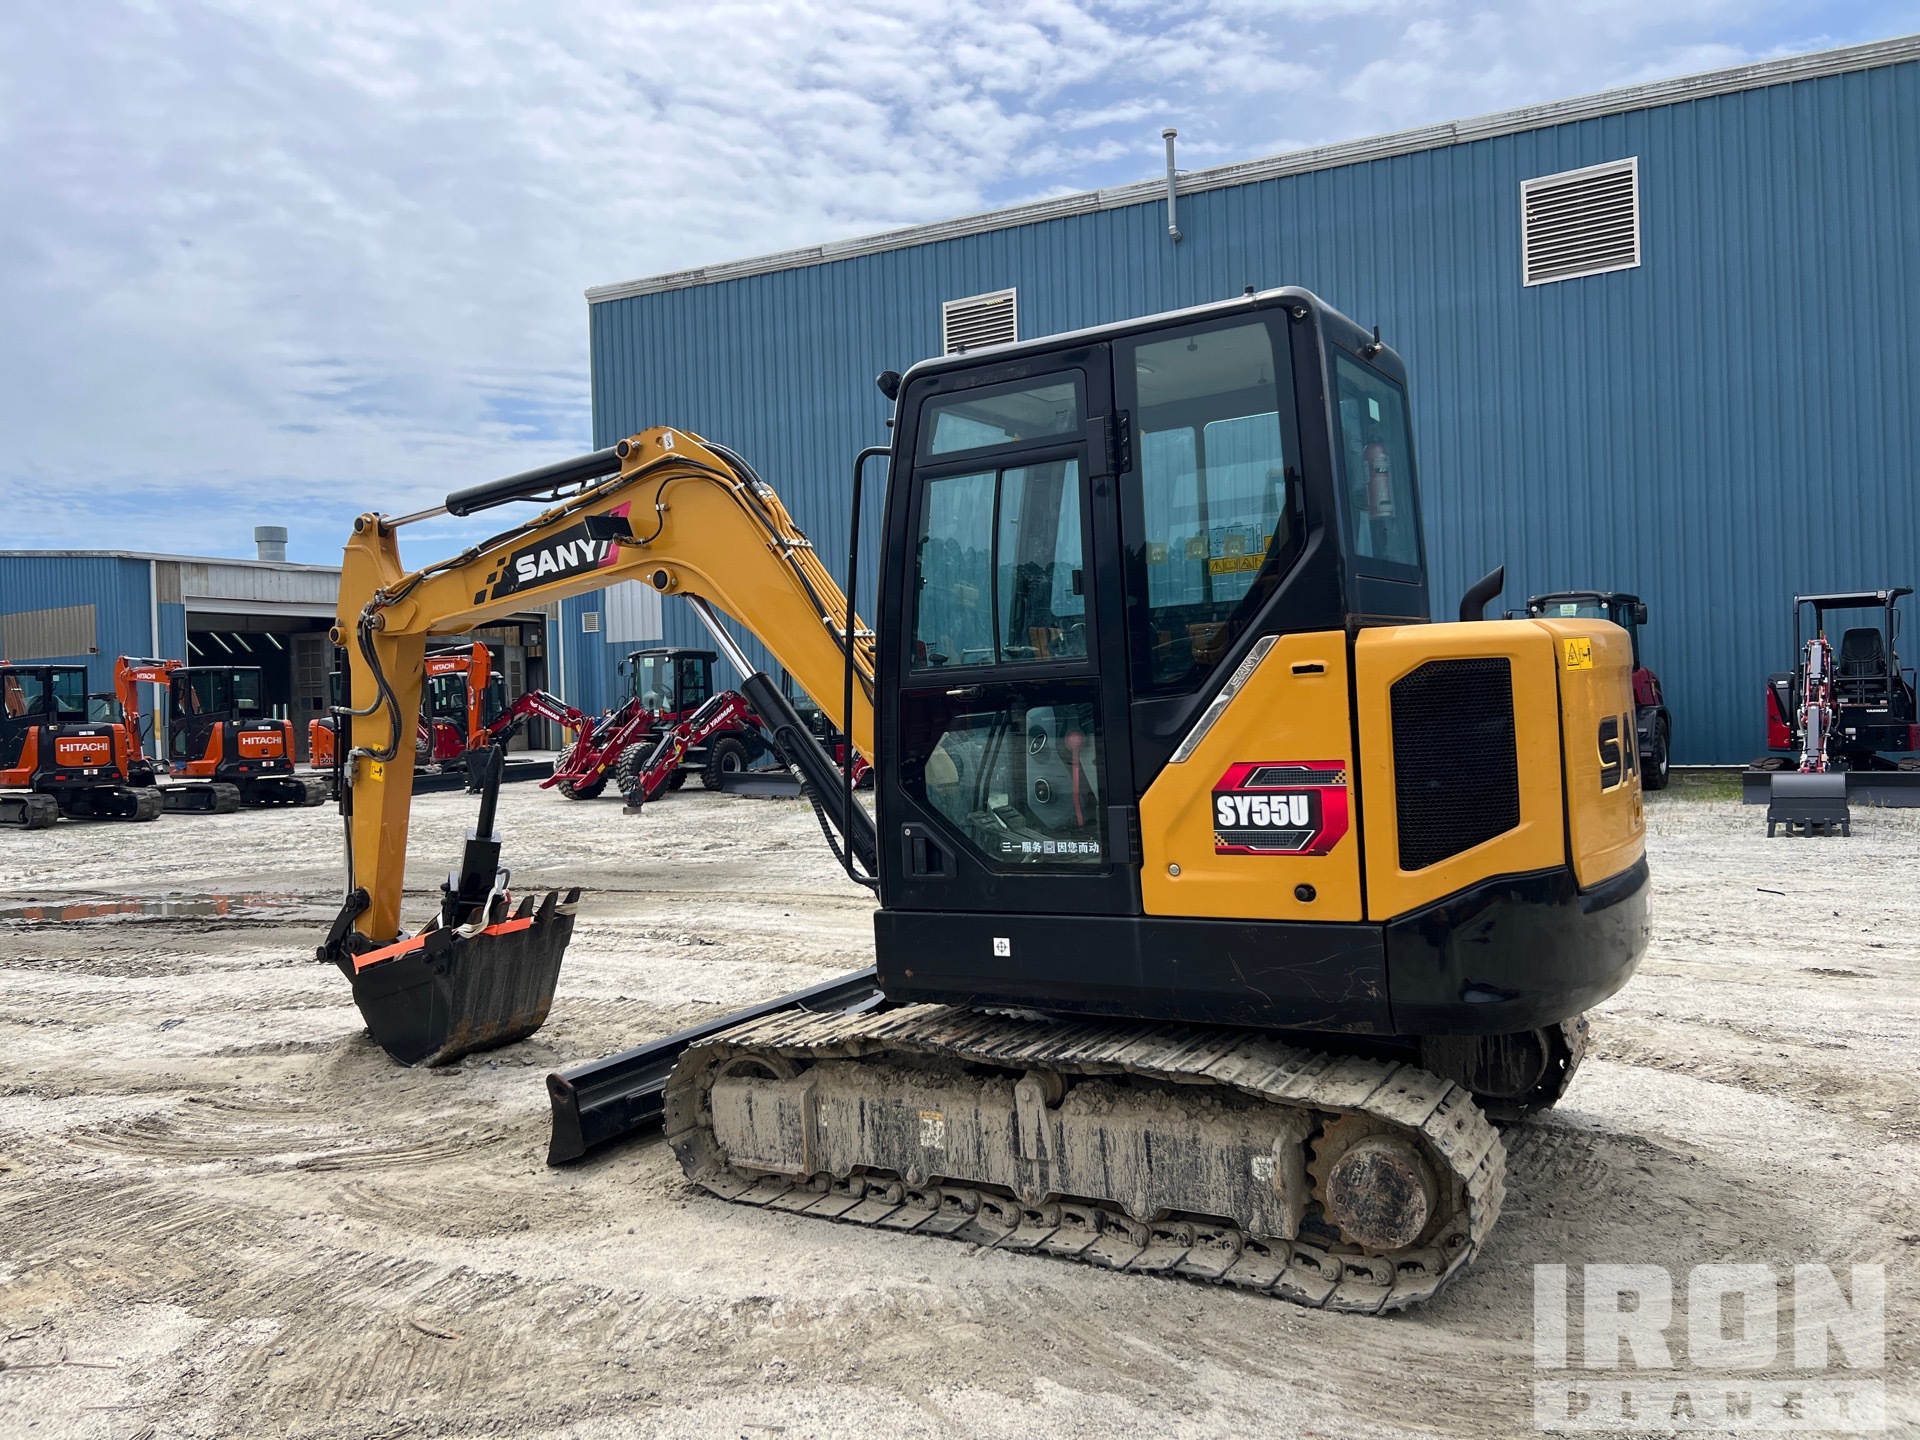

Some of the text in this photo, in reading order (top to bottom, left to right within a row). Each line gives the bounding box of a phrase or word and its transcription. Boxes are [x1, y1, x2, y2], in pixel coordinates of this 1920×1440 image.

[515, 539, 597, 582] SANY
[432, 663, 455, 671] HITACHI
[1230, 650, 1259, 688] SANY
[538, 705, 560, 721] YANMAR
[710, 704, 735, 728] YANMAR
[623, 718, 640, 737] YANMAR
[60, 743, 108, 752] HITACHI
[242, 736, 282, 745] HITACHI
[1217, 795, 1309, 826] SY55U
[1001, 841, 1042, 853] 三一服务
